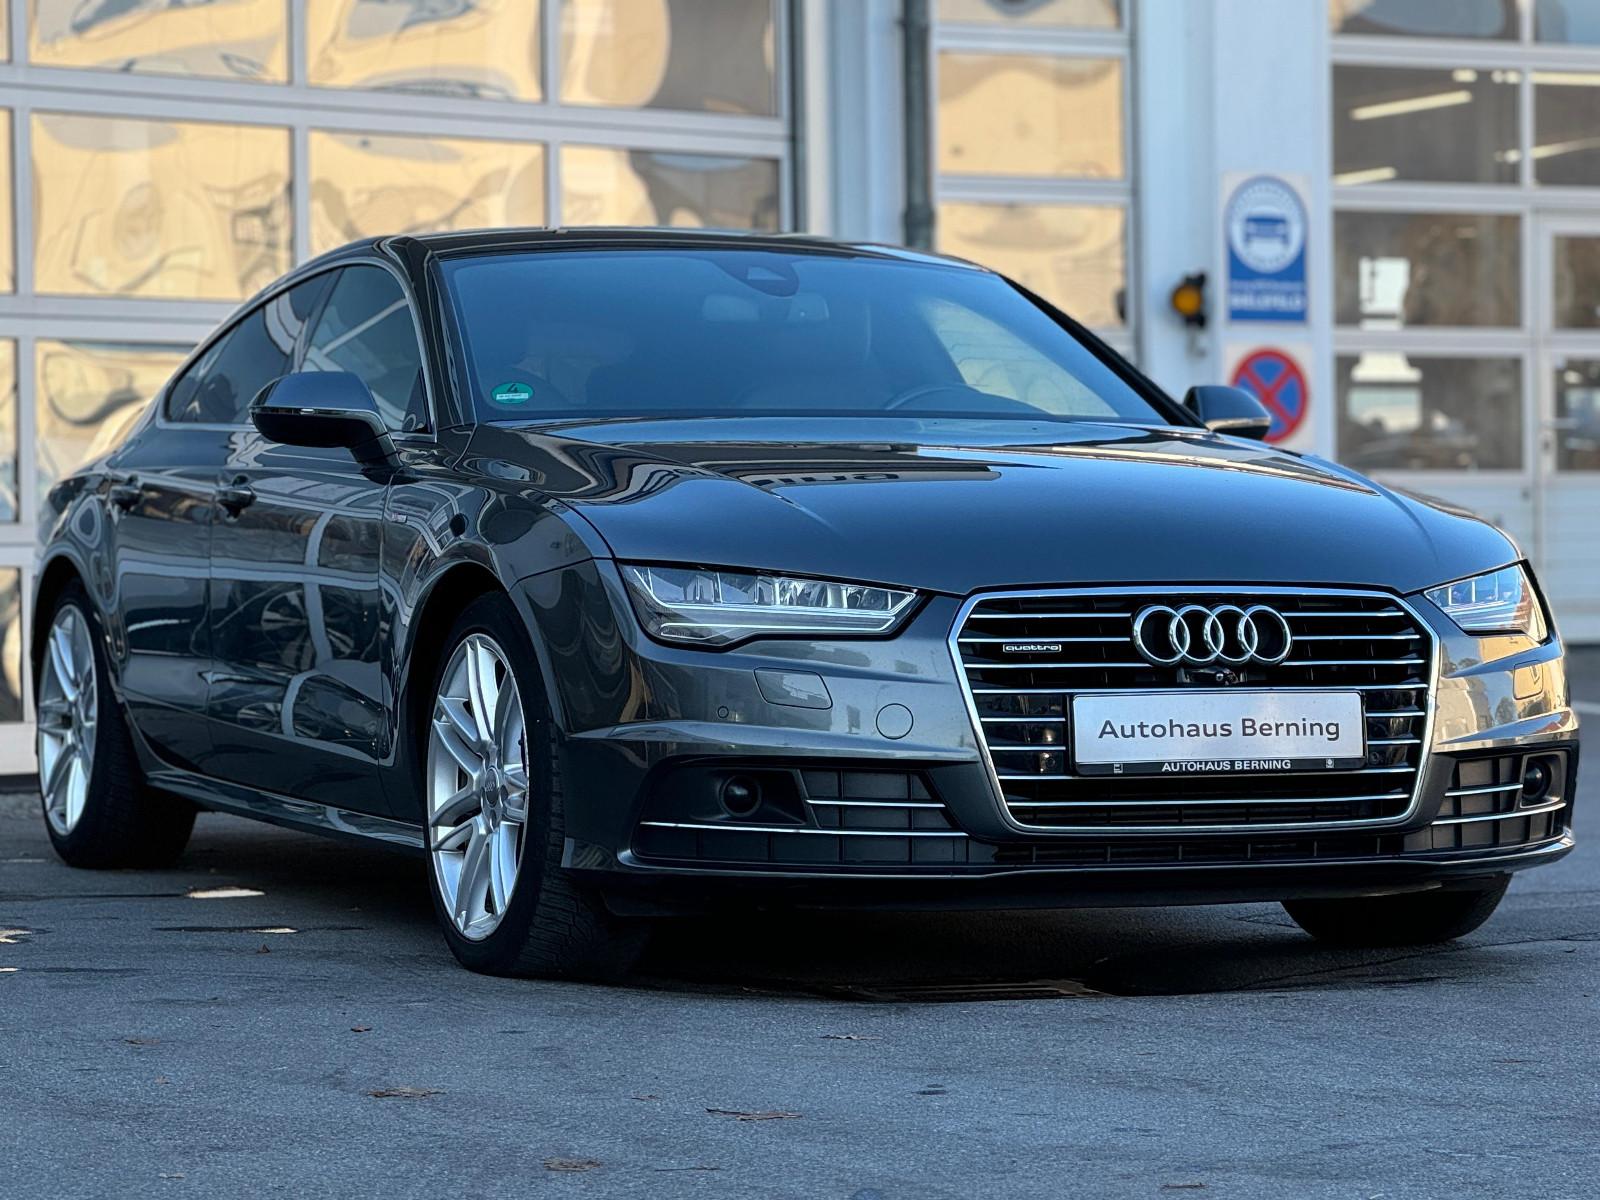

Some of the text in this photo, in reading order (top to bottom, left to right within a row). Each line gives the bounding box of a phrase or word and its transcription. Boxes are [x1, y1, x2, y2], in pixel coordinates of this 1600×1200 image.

[507, 383, 519, 393] 4
[1005, 644, 1059, 652] quattro
[1098, 717, 1340, 741] Autohaus Berning
[1161, 759, 1291, 772] AUTOHAUS BERNING
